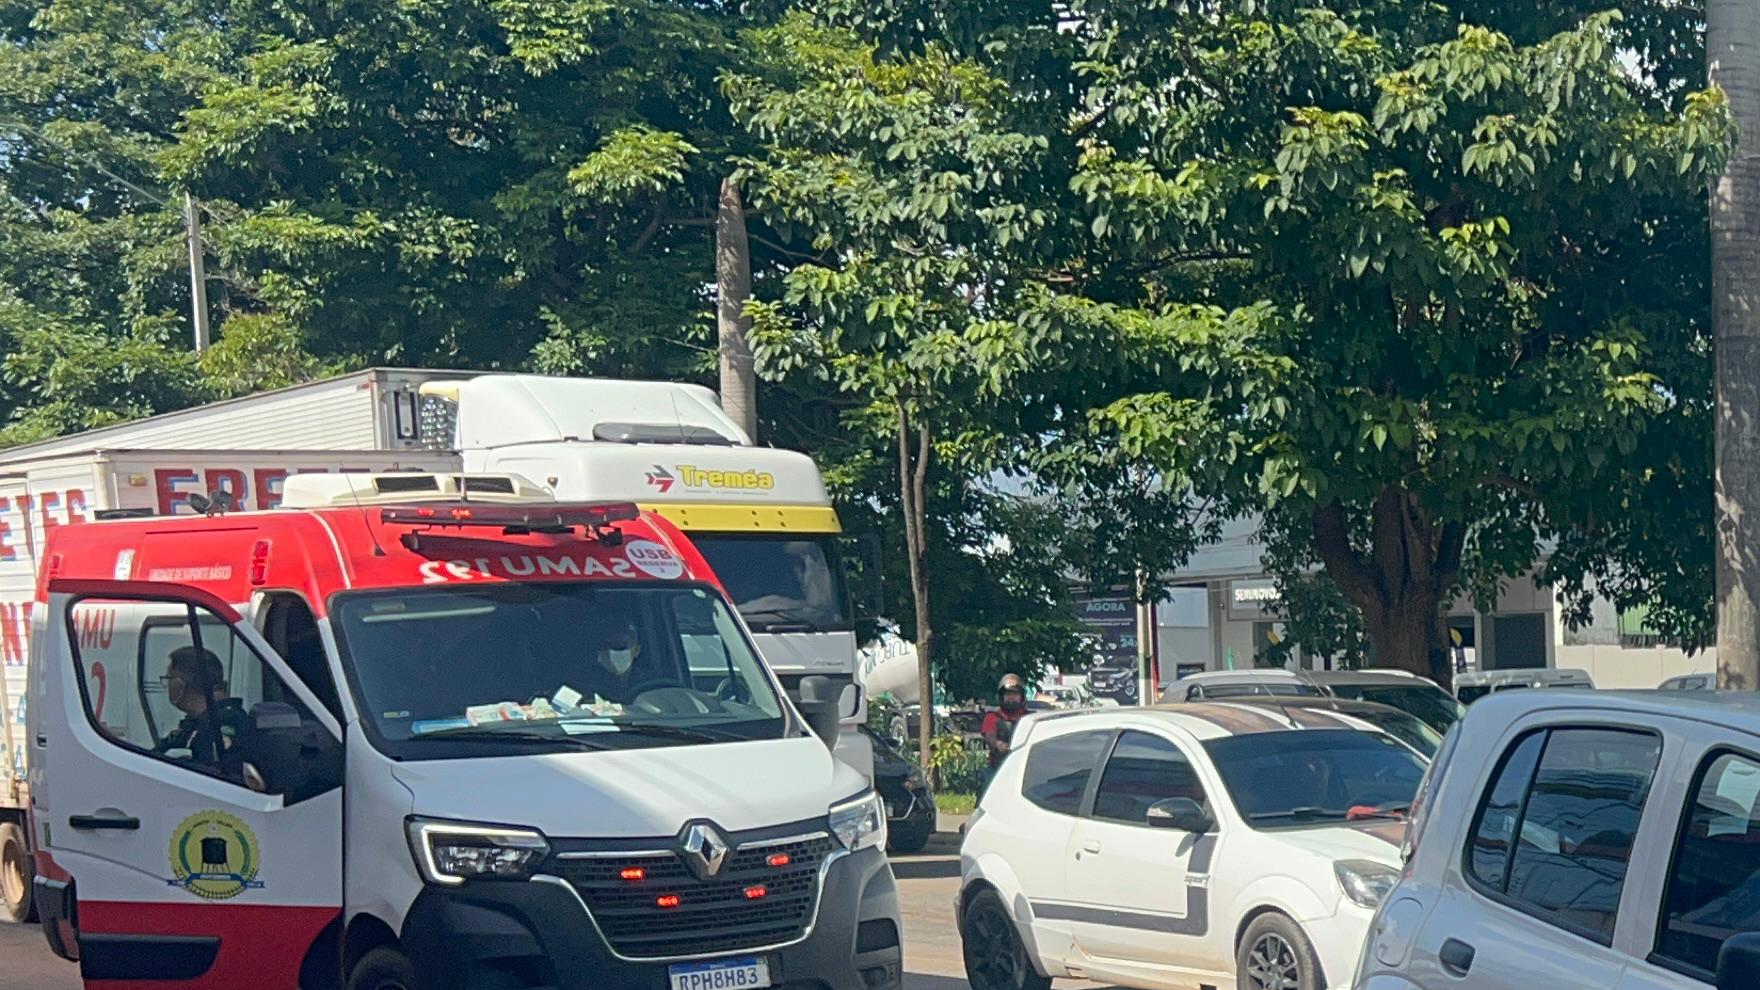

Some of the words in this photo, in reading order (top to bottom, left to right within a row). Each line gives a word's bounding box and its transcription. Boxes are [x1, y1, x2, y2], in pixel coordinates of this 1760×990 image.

[676, 465, 775, 490] Treméa
[629, 548, 673, 560] USB
[1086, 602, 1126, 612] AGORA
